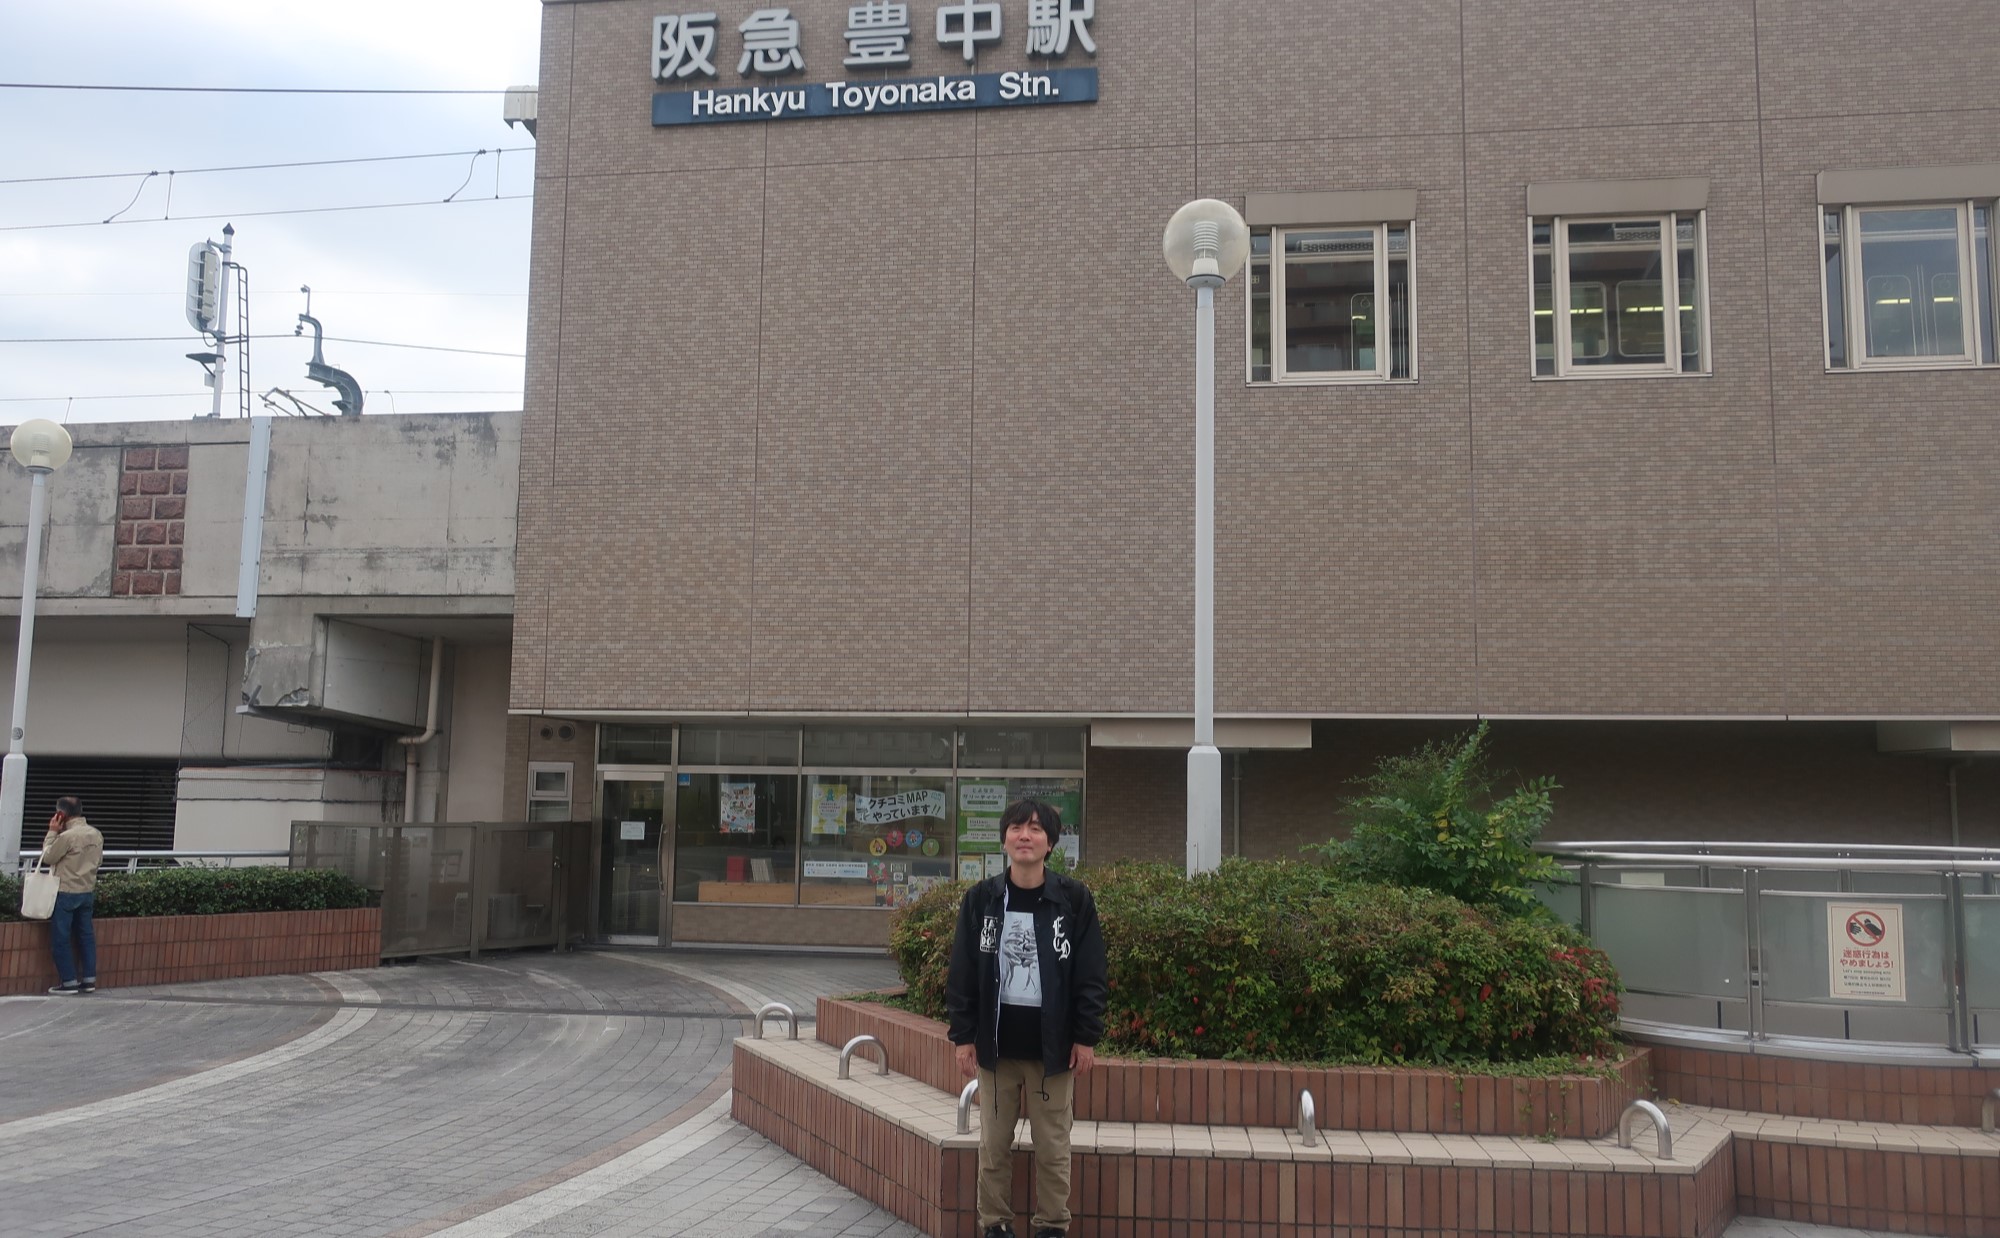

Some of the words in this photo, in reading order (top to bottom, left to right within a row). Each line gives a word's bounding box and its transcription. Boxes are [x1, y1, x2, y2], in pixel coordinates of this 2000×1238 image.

[651, 0, 1096, 80] 阪急豊中駅
[692, 86, 806, 118] Hankyu
[825, 75, 977, 112] Toyonaka
[998, 71, 1060, 99] Stn.
[1840, 958, 1894, 968] やめましょう!
[1843, 949, 1889, 959] 迷惑行為は
